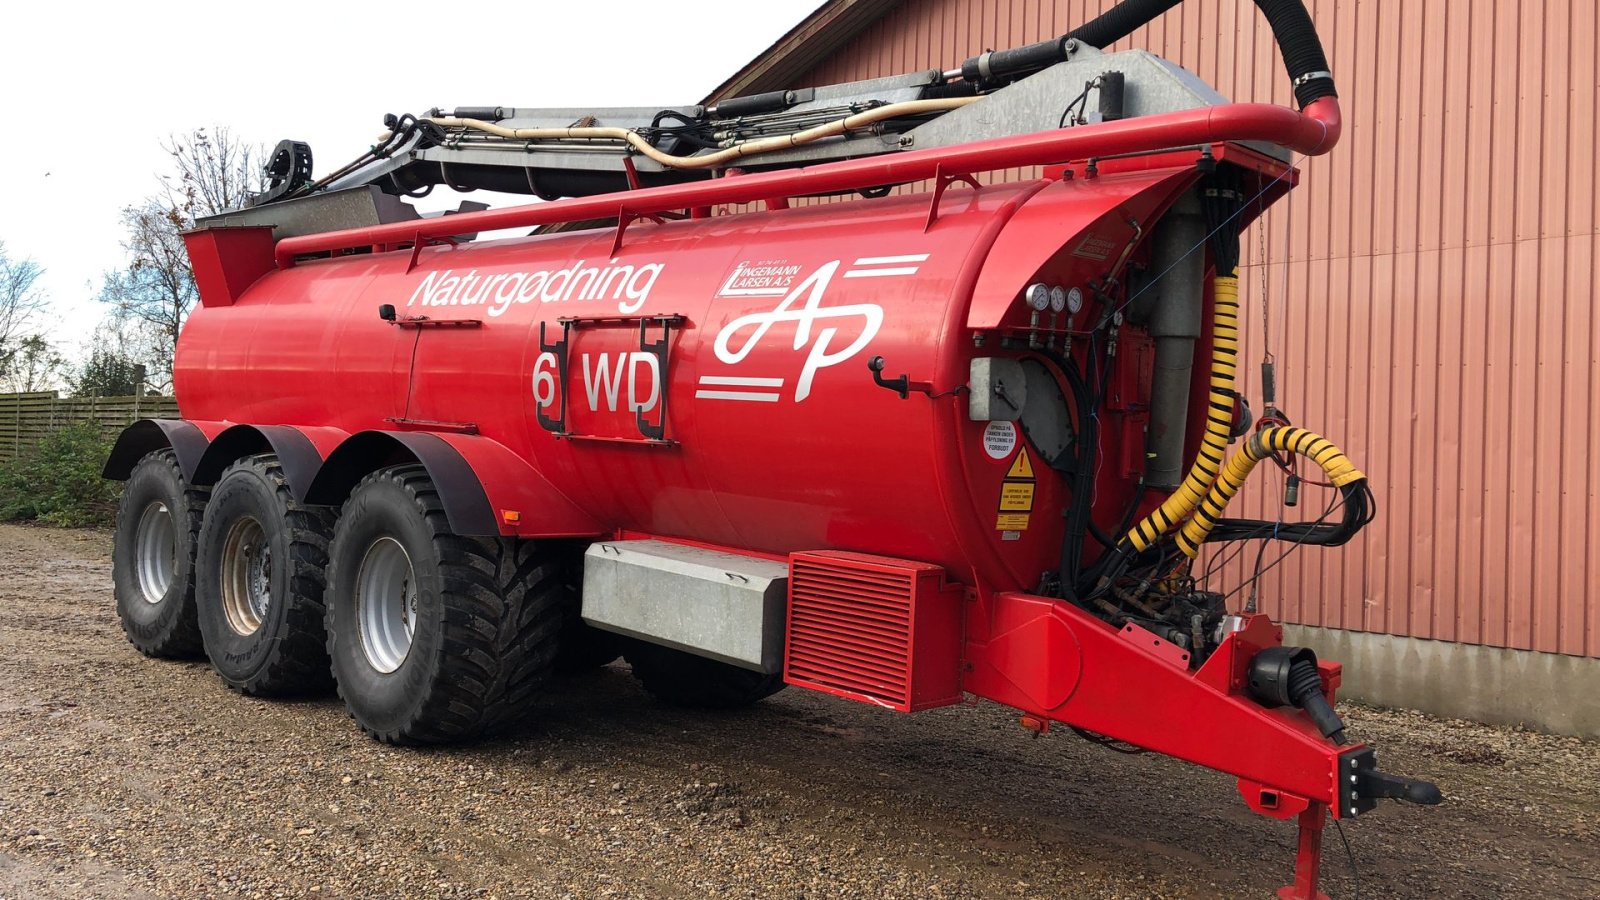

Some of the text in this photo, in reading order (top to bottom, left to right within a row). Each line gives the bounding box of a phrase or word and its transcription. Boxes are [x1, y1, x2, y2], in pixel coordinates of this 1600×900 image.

[406, 258, 666, 317] Naturgødning
[732, 275, 795, 287] LARSEN A/S
[532, 351, 661, 413] 6 WD
